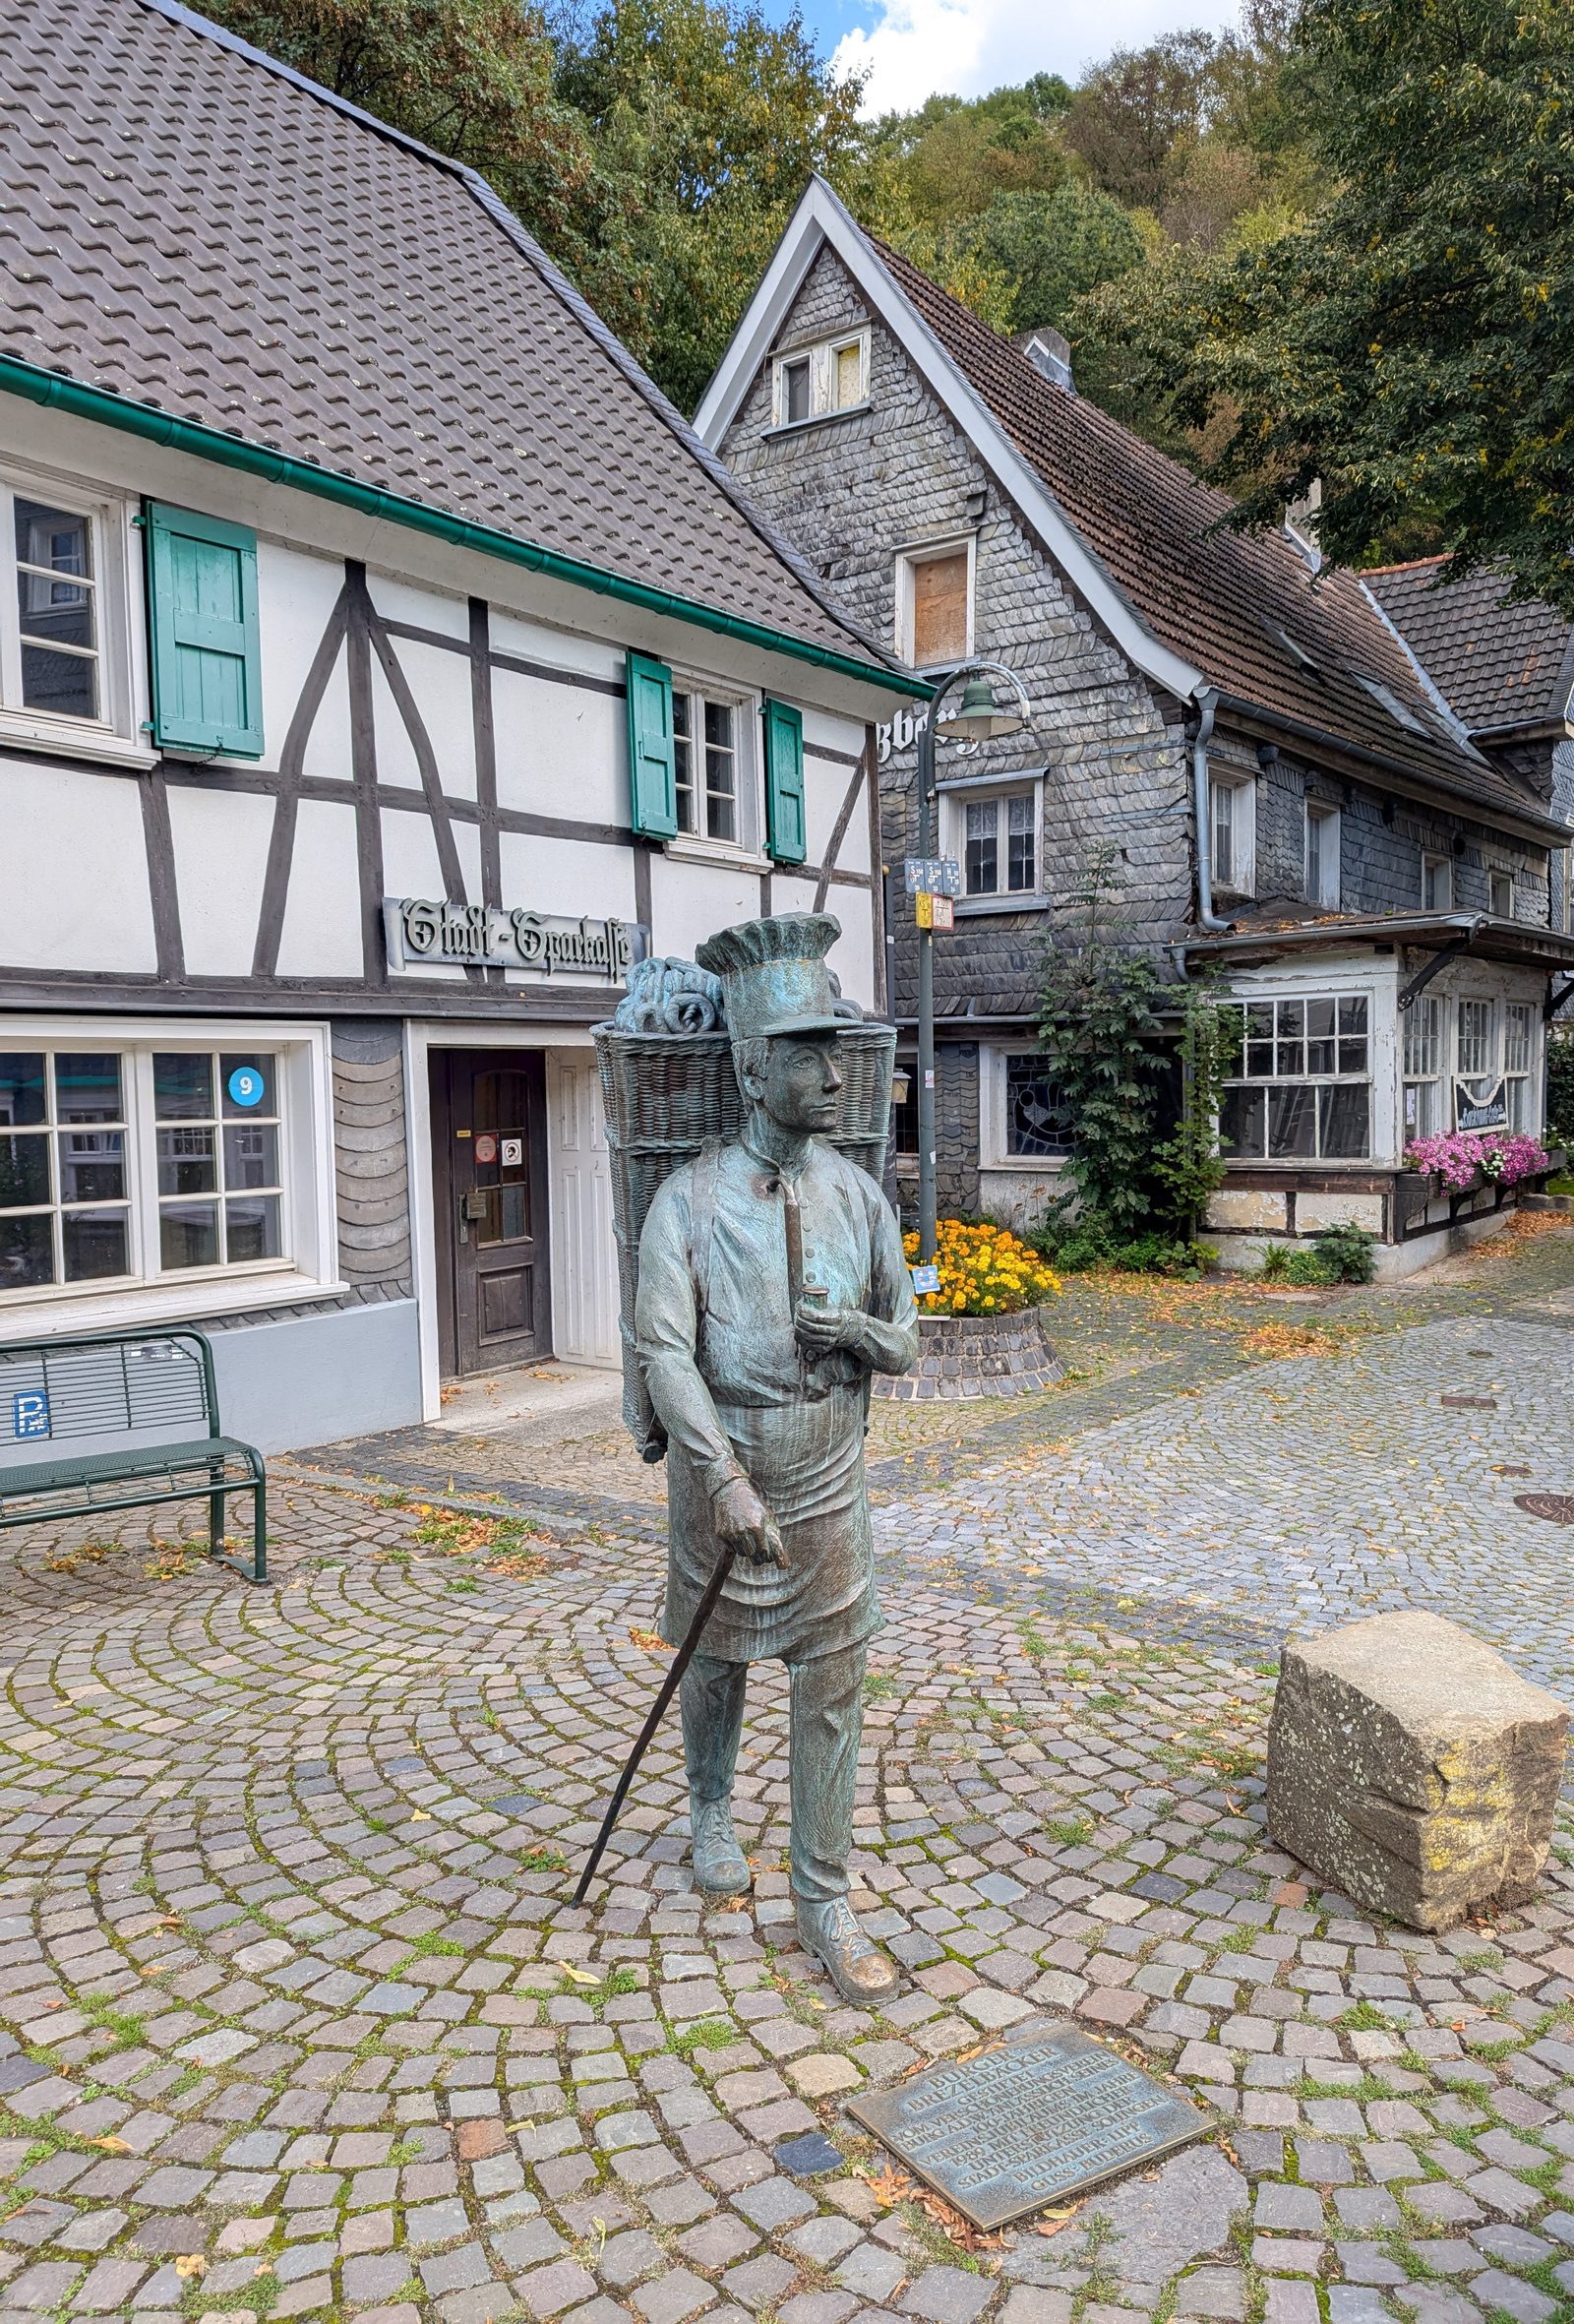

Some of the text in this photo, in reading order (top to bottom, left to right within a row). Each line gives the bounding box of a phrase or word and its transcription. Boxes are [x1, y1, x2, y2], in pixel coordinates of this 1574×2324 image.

[239, 1076, 253, 1095] 9
[956, 2071, 1035, 2105] GESTIFTET
[1071, 2091, 1092, 2102] IM
[1092, 2072, 1138, 2093] JAHRE
[902, 2129, 944, 2150] BURG
[1070, 2058, 1119, 2080] SEINES
[1091, 2096, 1166, 2130] SOLINGEN
[1102, 2097, 1134, 2112] DER
[891, 2124, 929, 2142] VOM
[1107, 2122, 1142, 2140] LIPP
[950, 2147, 987, 2166] 1989
[988, 2134, 1018, 2150] MIT
